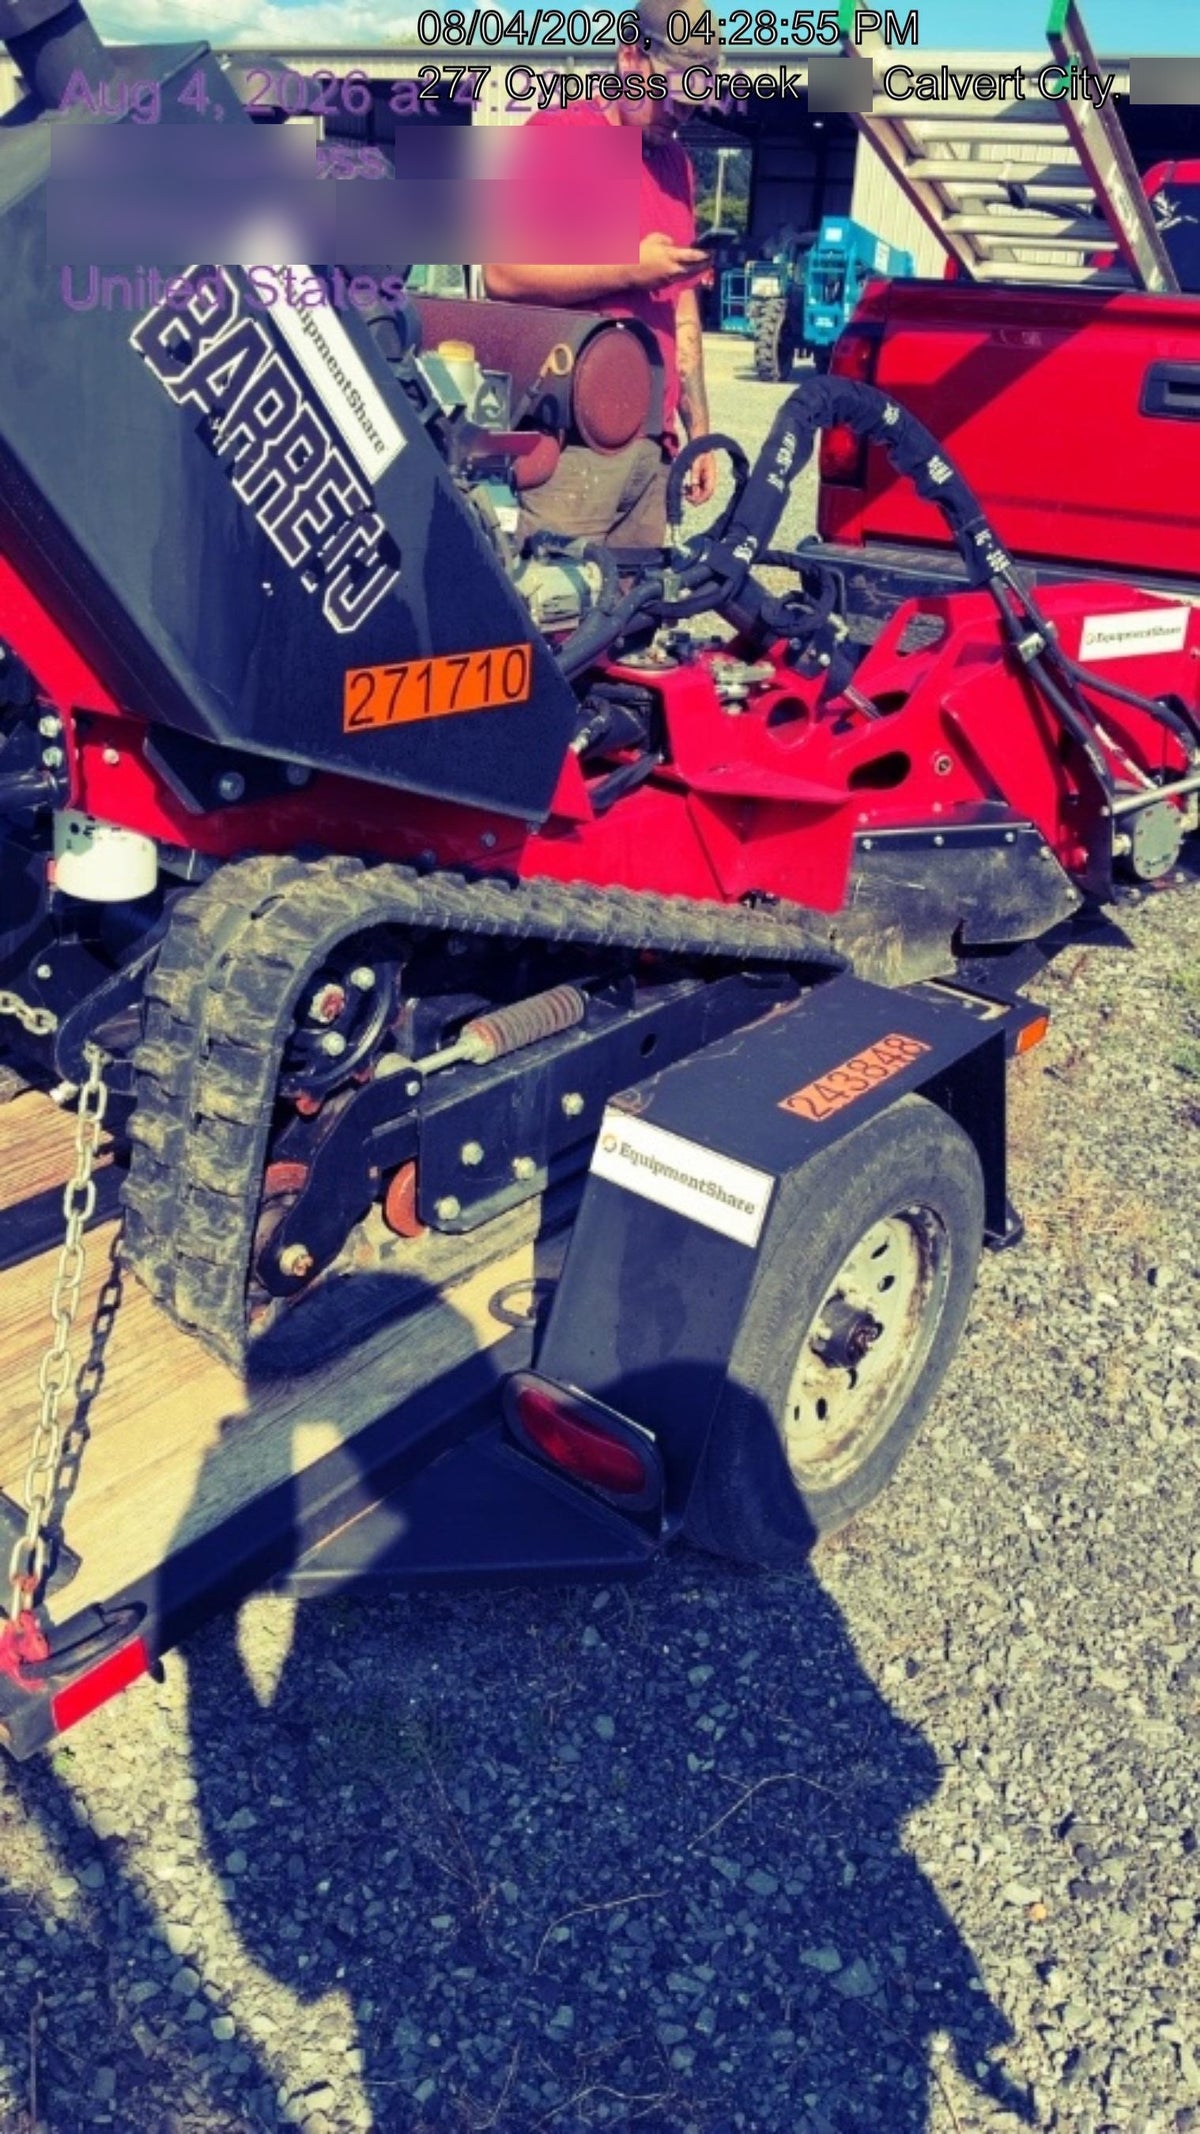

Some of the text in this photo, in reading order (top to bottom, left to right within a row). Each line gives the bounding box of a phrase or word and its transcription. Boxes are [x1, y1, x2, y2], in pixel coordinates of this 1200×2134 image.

[348, 647, 528, 728] 271710
[787, 1038, 923, 1117] 243848
[618, 1142, 755, 1215] EquipmentShare
